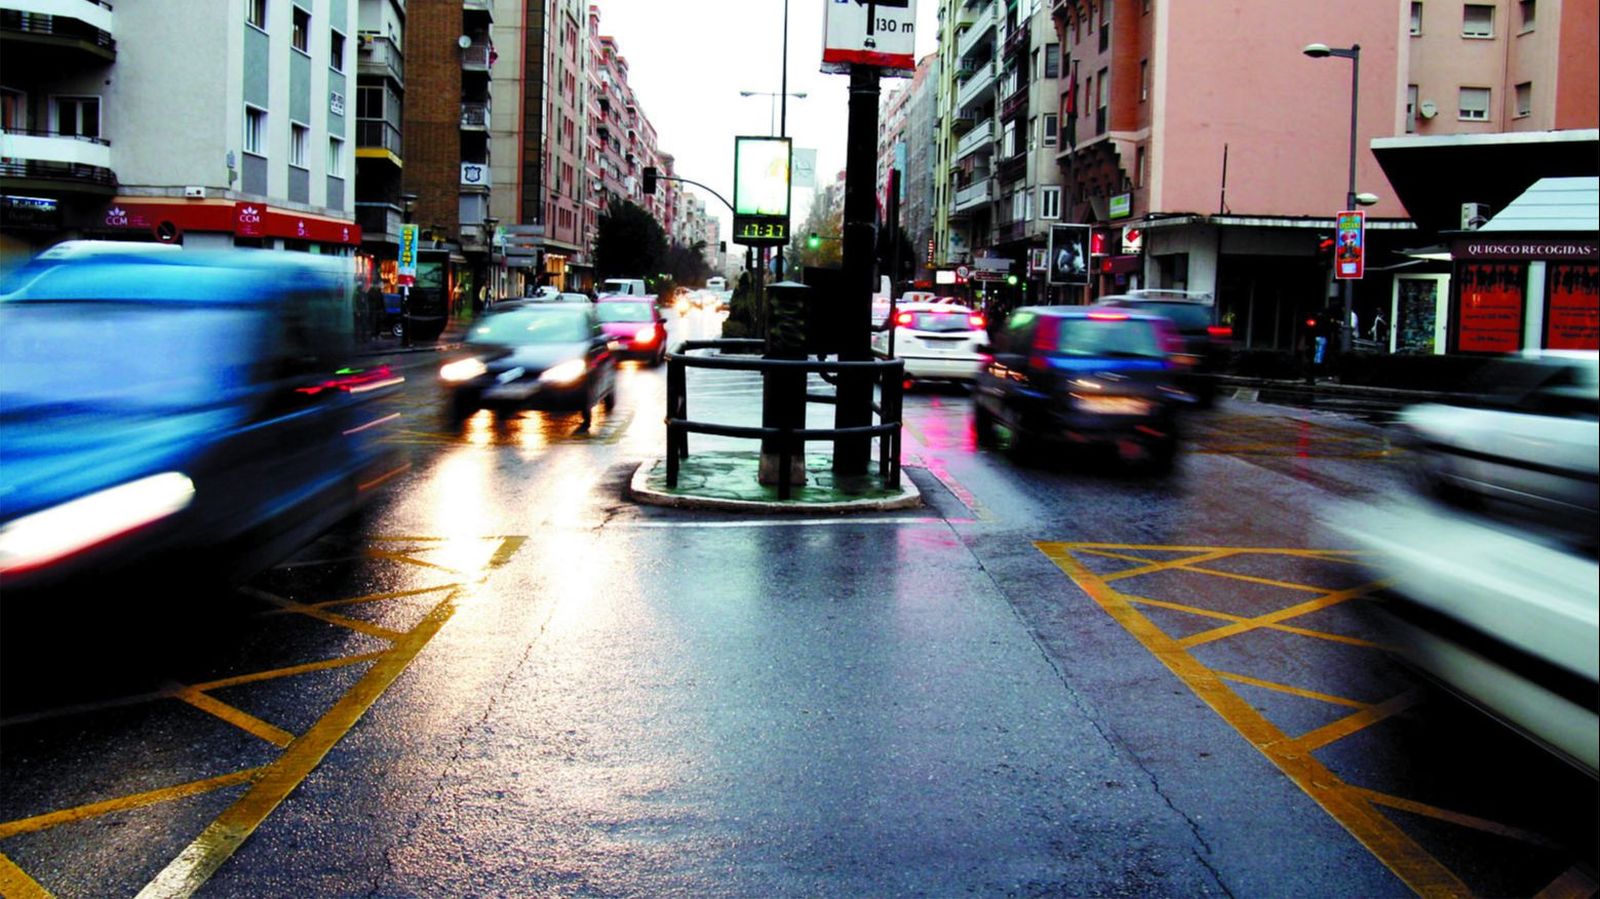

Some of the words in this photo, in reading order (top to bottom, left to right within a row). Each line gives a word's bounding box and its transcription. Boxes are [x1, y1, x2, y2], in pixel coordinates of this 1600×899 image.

[876, 18, 897, 32] 130
[902, 23, 914, 33] m
[105, 216, 128, 225] CCM
[240, 214, 260, 223] CCM
[743, 224, 784, 238] 17:37
[1468, 244, 1520, 255] QUIOSCO
[1521, 245, 1591, 255] RECOGIDAS
